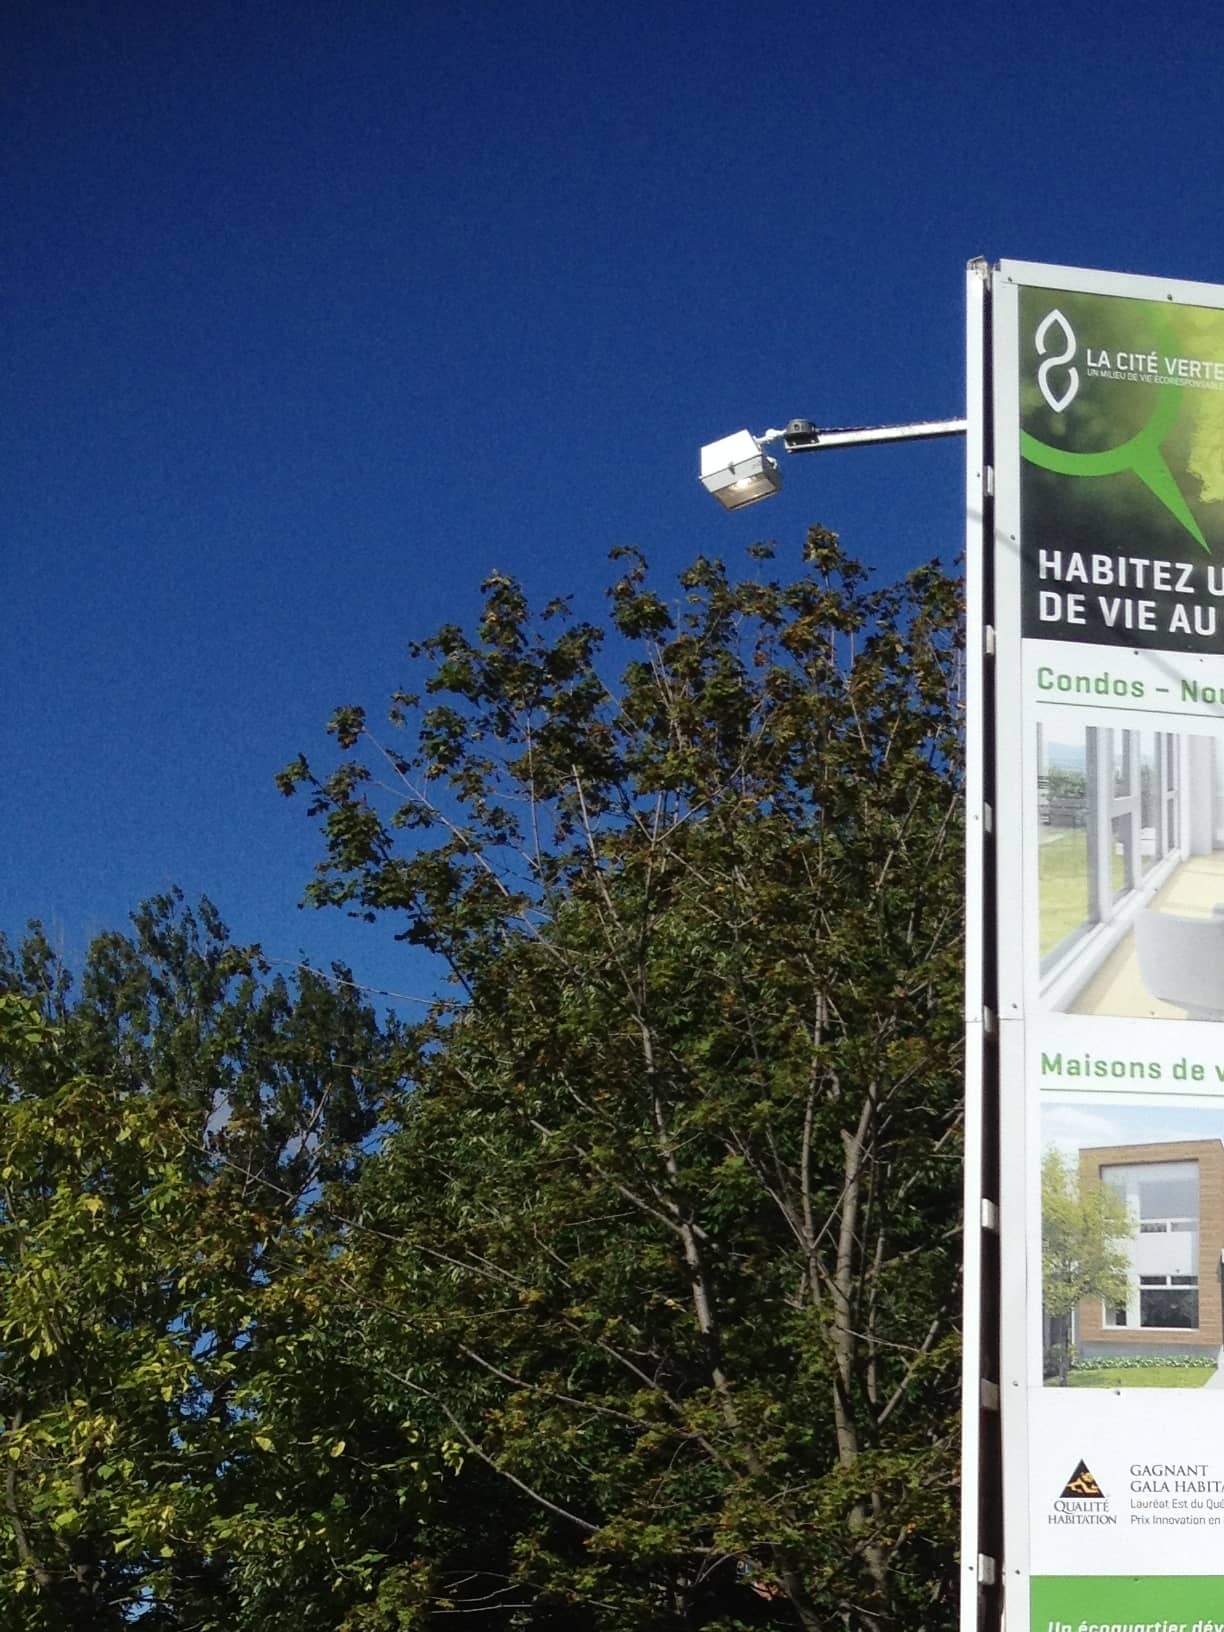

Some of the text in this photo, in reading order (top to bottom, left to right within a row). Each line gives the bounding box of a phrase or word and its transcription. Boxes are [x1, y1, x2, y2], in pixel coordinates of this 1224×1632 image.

[1086, 348, 1224, 381] LA CITÉ VERTE
[1038, 549, 1195, 594] HABITEZ
[1039, 590, 1087, 624] DE
[1098, 596, 1157, 631] VIE
[1169, 603, 1216, 636] AU
[1037, 667, 1144, 698] Condos
[1041, 1052, 1162, 1079] Maisons
[1172, 1057, 1205, 1081] de
[1130, 1464, 1208, 1477] GAGNANT
[1130, 1480, 1170, 1493] GALA
[1053, 1499, 1110, 1515] QUALITÉ
[1130, 1499, 1168, 1509] Lauréat
[1171, 1499, 1188, 1509] Est
[1190, 1499, 1204, 1509] du
[1047, 1514, 1118, 1525] HABITATION
[1130, 1514, 1150, 1526] Prix
[1152, 1514, 1206, 1526] Innovation
[1208, 1516, 1221, 1526] en
